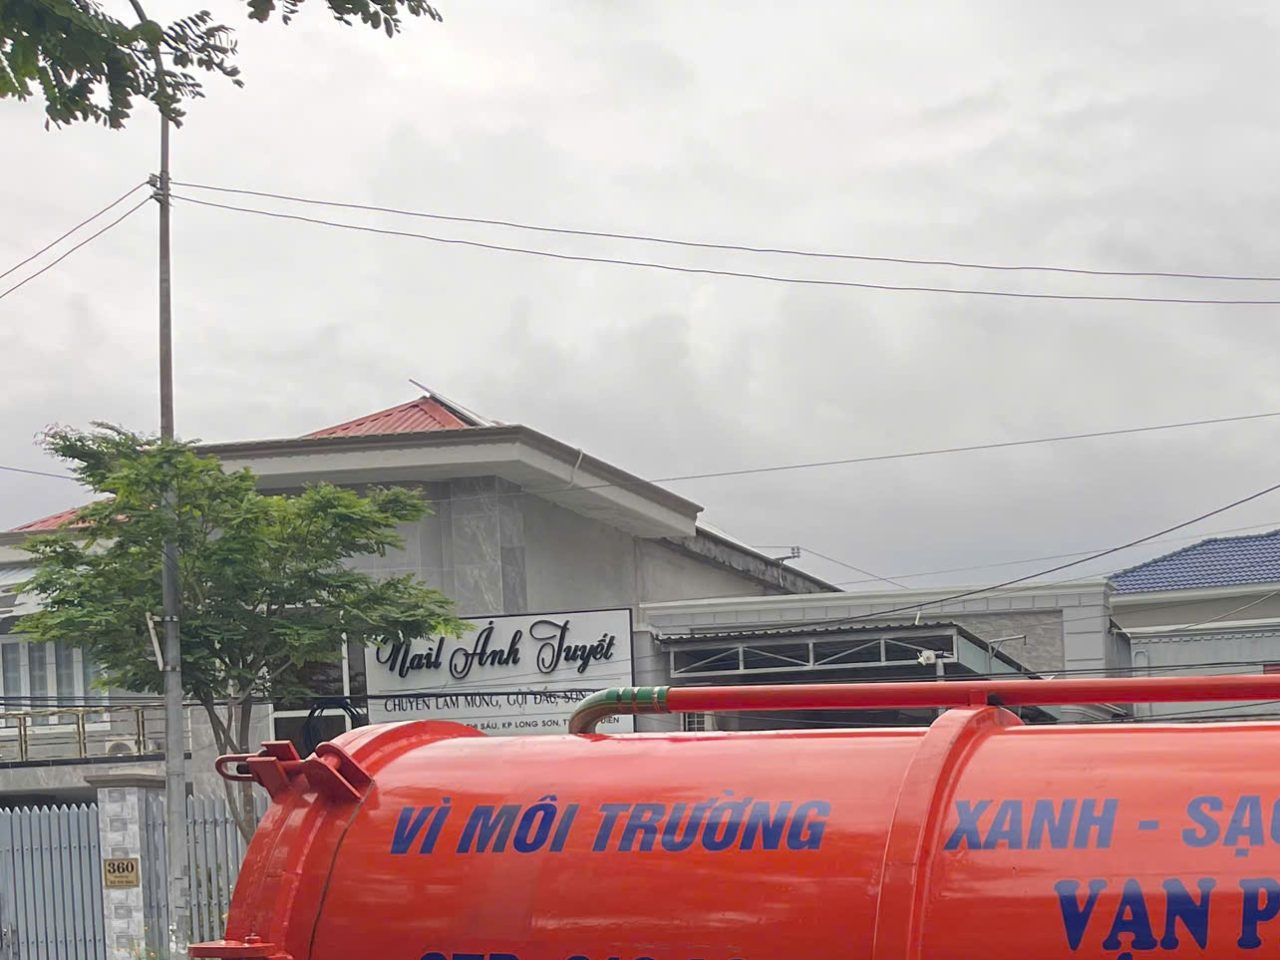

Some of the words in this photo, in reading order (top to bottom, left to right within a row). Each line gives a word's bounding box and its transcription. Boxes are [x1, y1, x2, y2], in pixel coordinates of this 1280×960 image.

[449, 620, 523, 679] Ánh
[529, 620, 616, 674] Tuyết
[515, 720, 538, 729] LONG
[390, 797, 453, 855] VÌ
[456, 794, 580, 854] MÔI
[592, 789, 832, 852] TRƯỜNG
[944, 798, 1120, 850] XANH
[107, 861, 135, 874] 360
